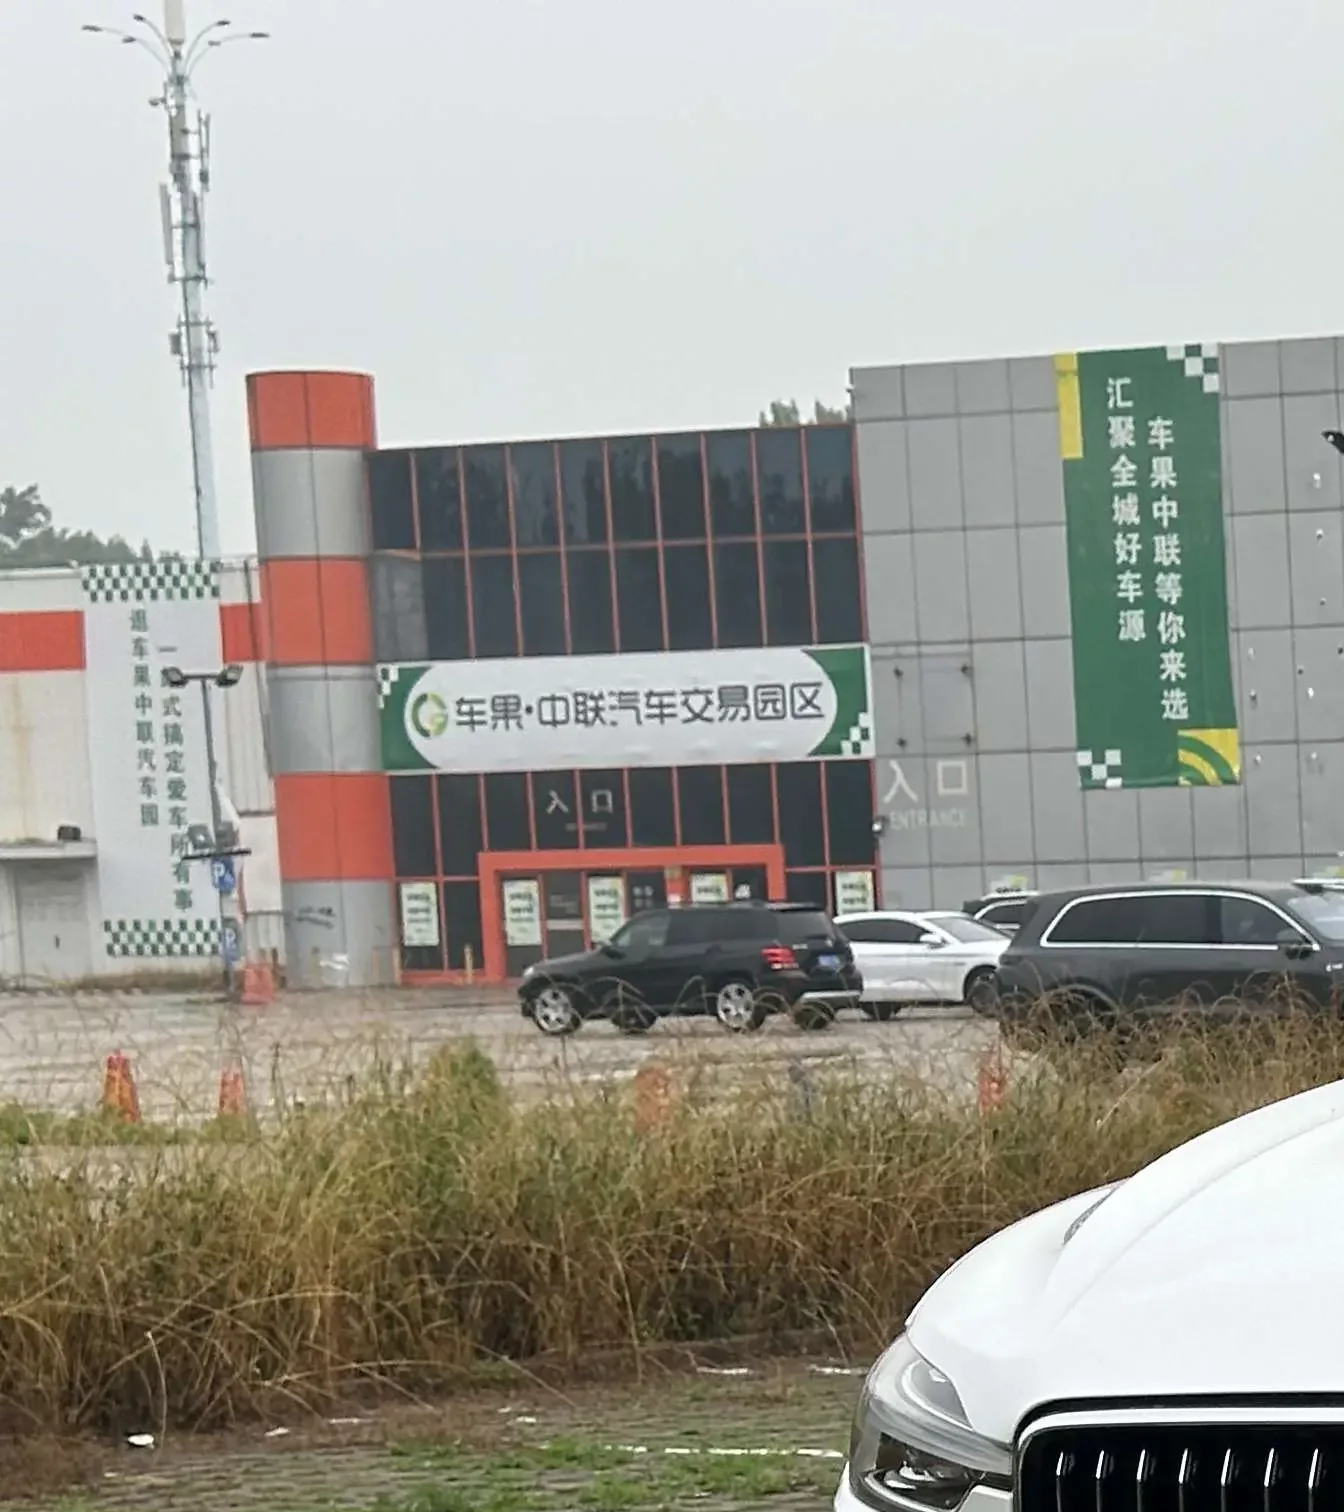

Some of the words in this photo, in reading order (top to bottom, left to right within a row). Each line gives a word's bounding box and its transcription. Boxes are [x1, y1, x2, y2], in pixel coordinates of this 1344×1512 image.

[1107, 376, 1146, 641] 汇聚全城好车源
[1148, 416, 1190, 720] 车果中联等你来选
[546, 789, 613, 814] 入口
[883, 760, 968, 803] 入口
